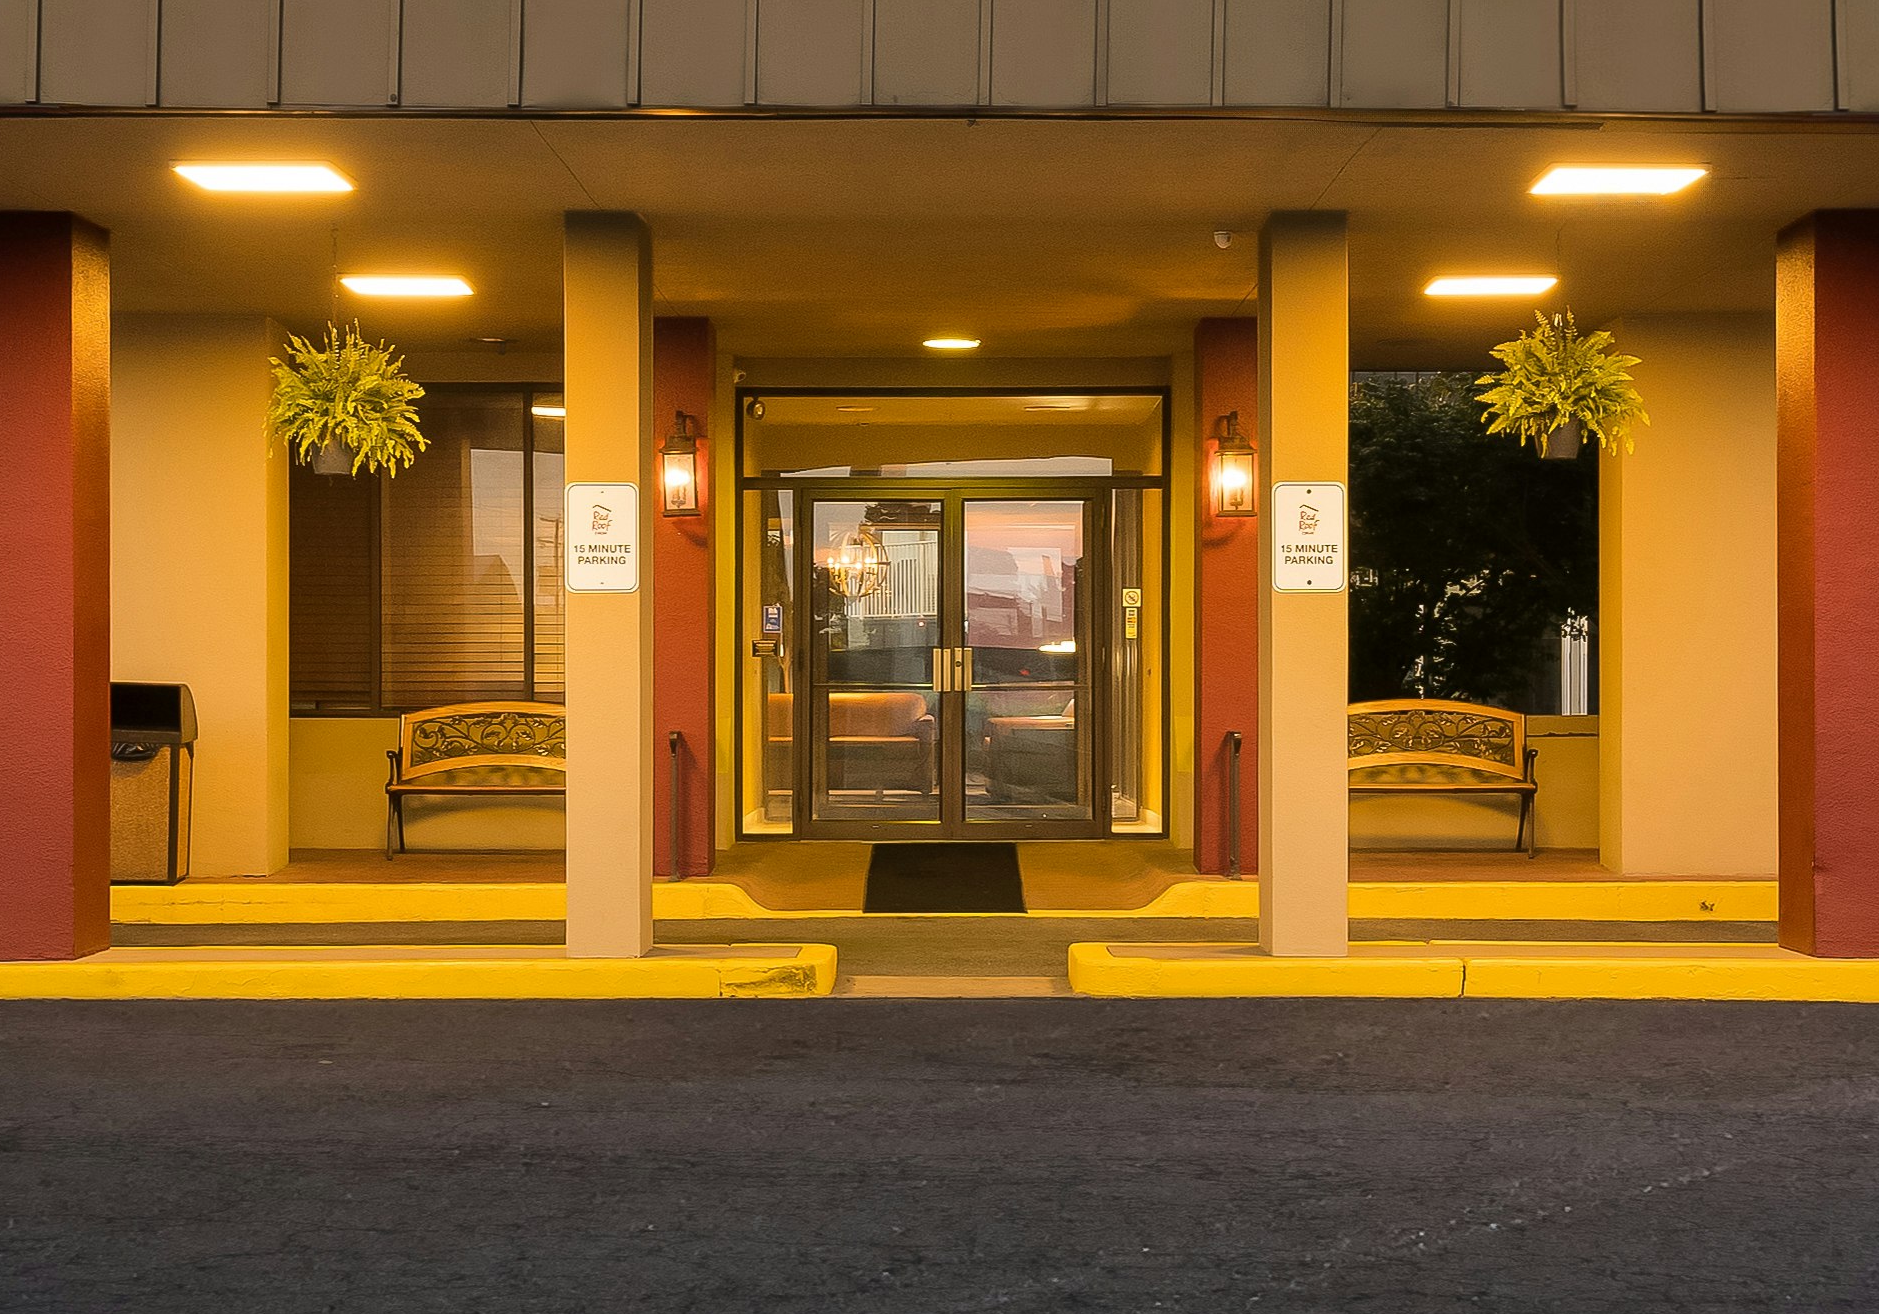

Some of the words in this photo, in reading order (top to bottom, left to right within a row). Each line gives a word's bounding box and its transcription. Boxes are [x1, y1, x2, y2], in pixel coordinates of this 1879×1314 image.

[593, 511, 609, 520] Red
[592, 520, 613, 531] Roof
[574, 544, 585, 553] 15
[588, 544, 631, 553] MINUTE
[1281, 544, 1292, 553] 15
[1295, 544, 1338, 553] MINUTE
[577, 556, 626, 564] PARKING
[1284, 556, 1333, 564] PARKING
